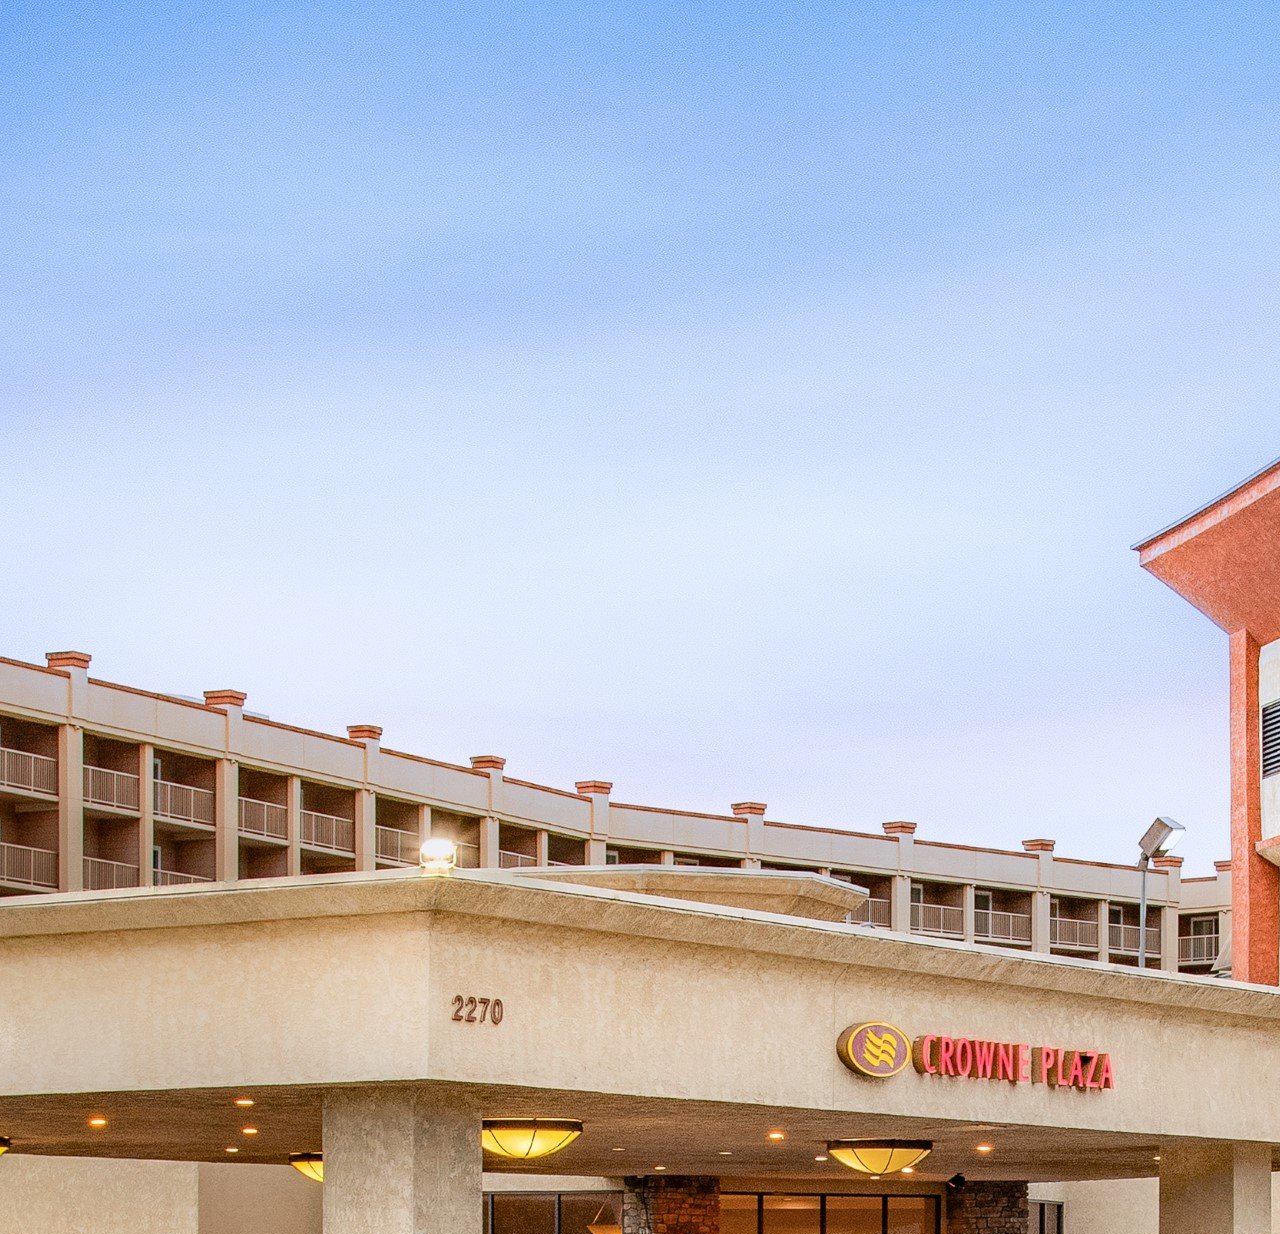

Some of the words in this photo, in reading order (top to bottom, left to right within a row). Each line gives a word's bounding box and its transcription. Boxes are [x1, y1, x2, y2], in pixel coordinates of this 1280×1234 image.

[451, 994, 504, 1025] 2270
[918, 1034, 1030, 1082] CROWNE
[1036, 1046, 1114, 1089] PLAZA
